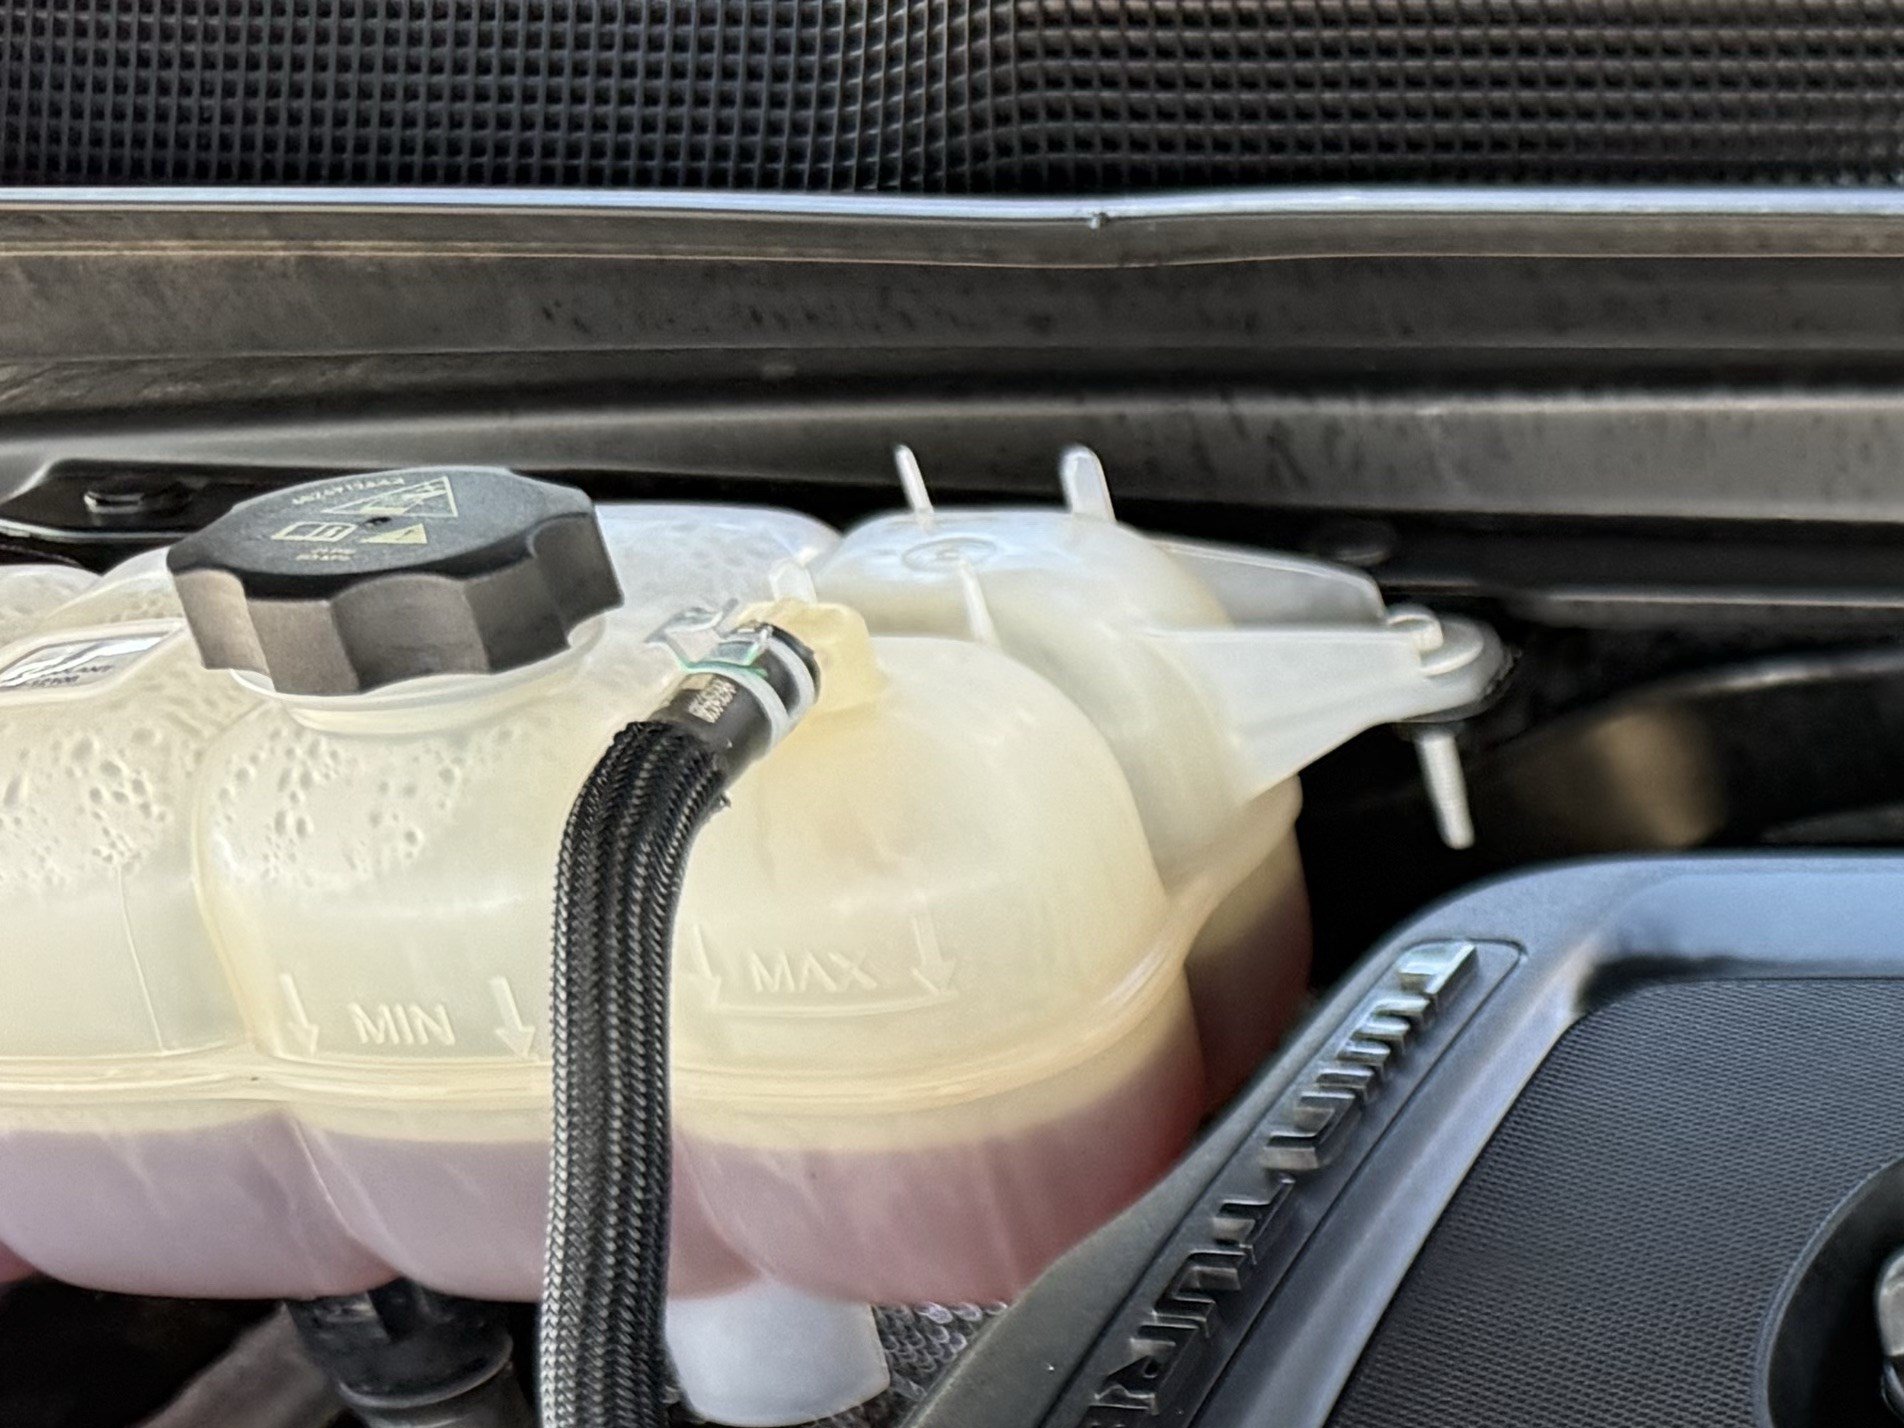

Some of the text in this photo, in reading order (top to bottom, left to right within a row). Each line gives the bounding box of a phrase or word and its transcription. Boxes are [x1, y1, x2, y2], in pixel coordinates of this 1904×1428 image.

[747, 949, 878, 993] MAX
[347, 1002, 457, 1047] MIN
[1259, 940, 1479, 1174] TWIN
